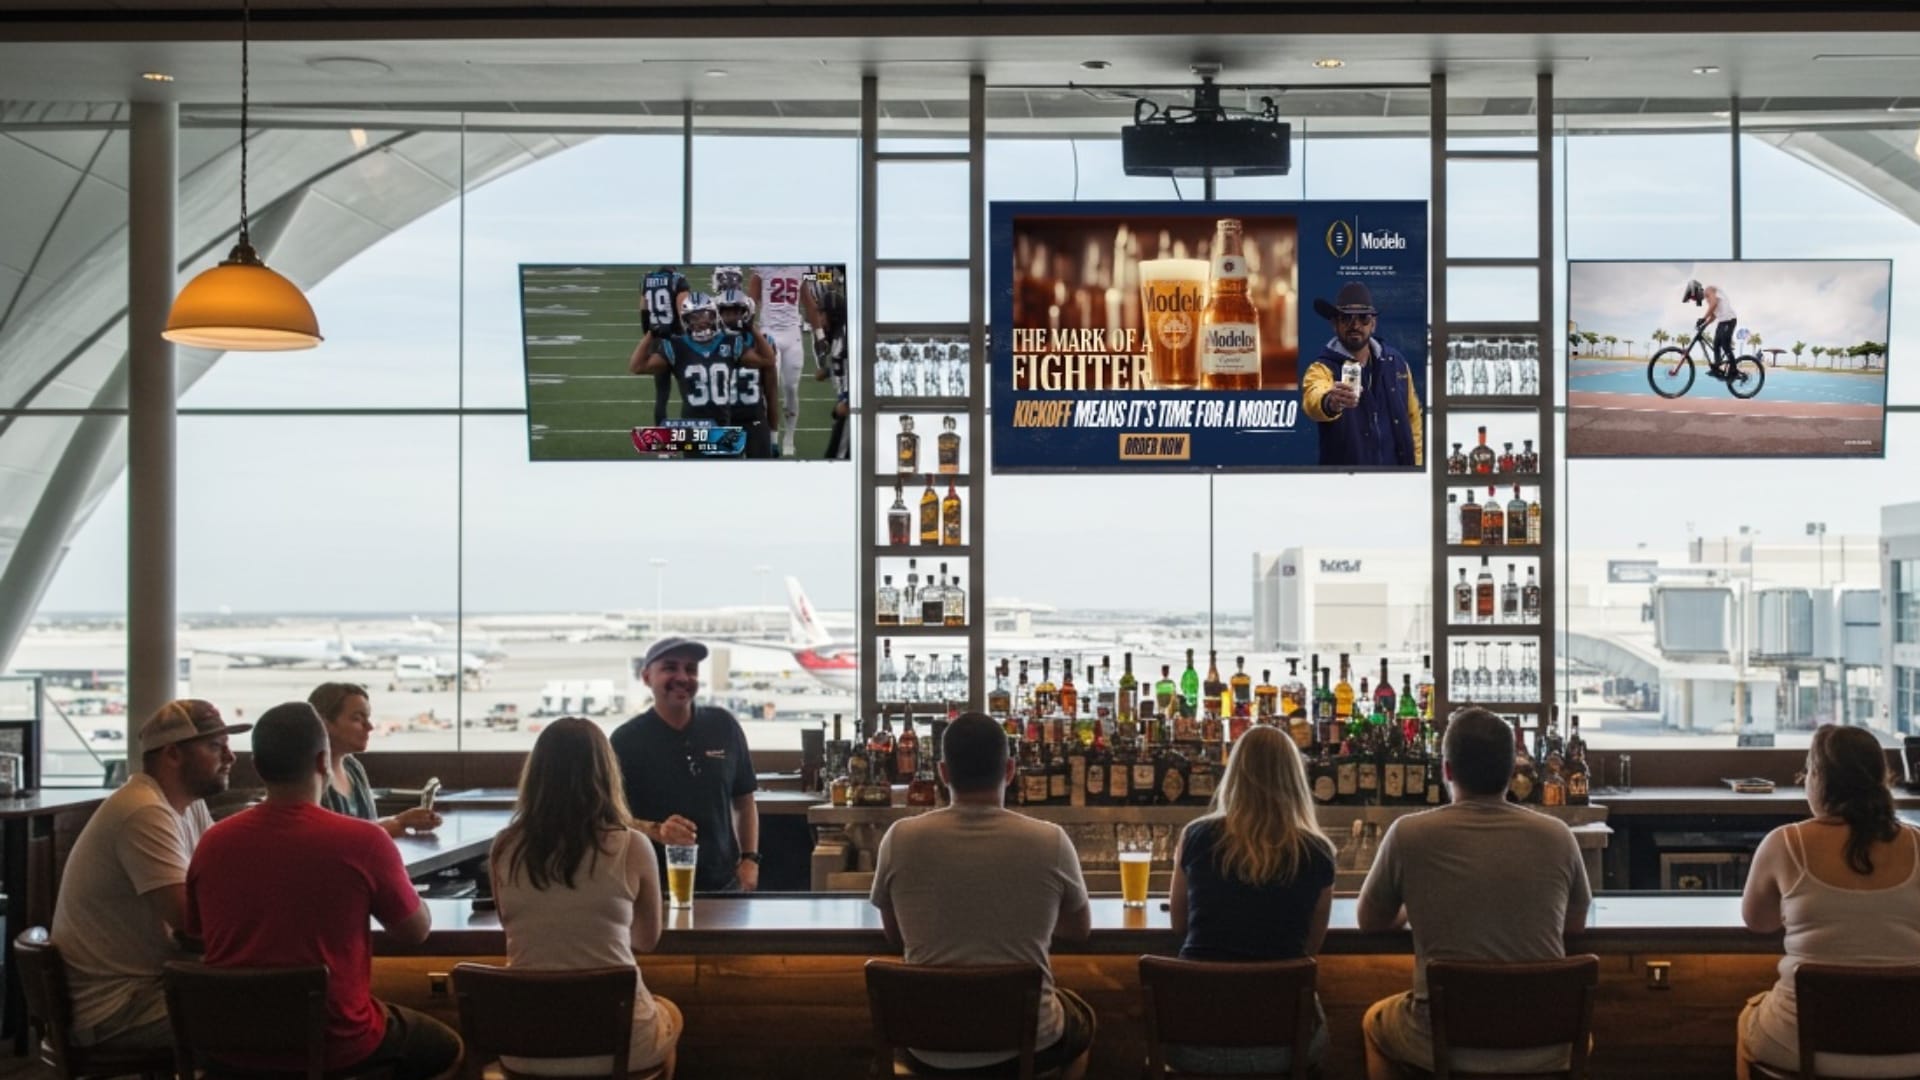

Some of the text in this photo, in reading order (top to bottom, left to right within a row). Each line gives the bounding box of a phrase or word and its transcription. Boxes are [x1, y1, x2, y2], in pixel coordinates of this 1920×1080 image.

[1361, 231, 1406, 250] Modelo
[769, 277, 799, 305] 25
[645, 288, 674, 325] 19
[1012, 328, 1154, 353] THE MARK OF A
[1207, 330, 1254, 348] Modelo
[684, 362, 730, 407] 30
[1012, 354, 1154, 391] FIGHTER
[1012, 399, 1298, 428] KICKOFF MEANS IT'S TIME FOR A MODELO
[671, 429, 686, 441] 30
[693, 429, 709, 441] 30
[1124, 437, 1185, 455] ORDER NOW
